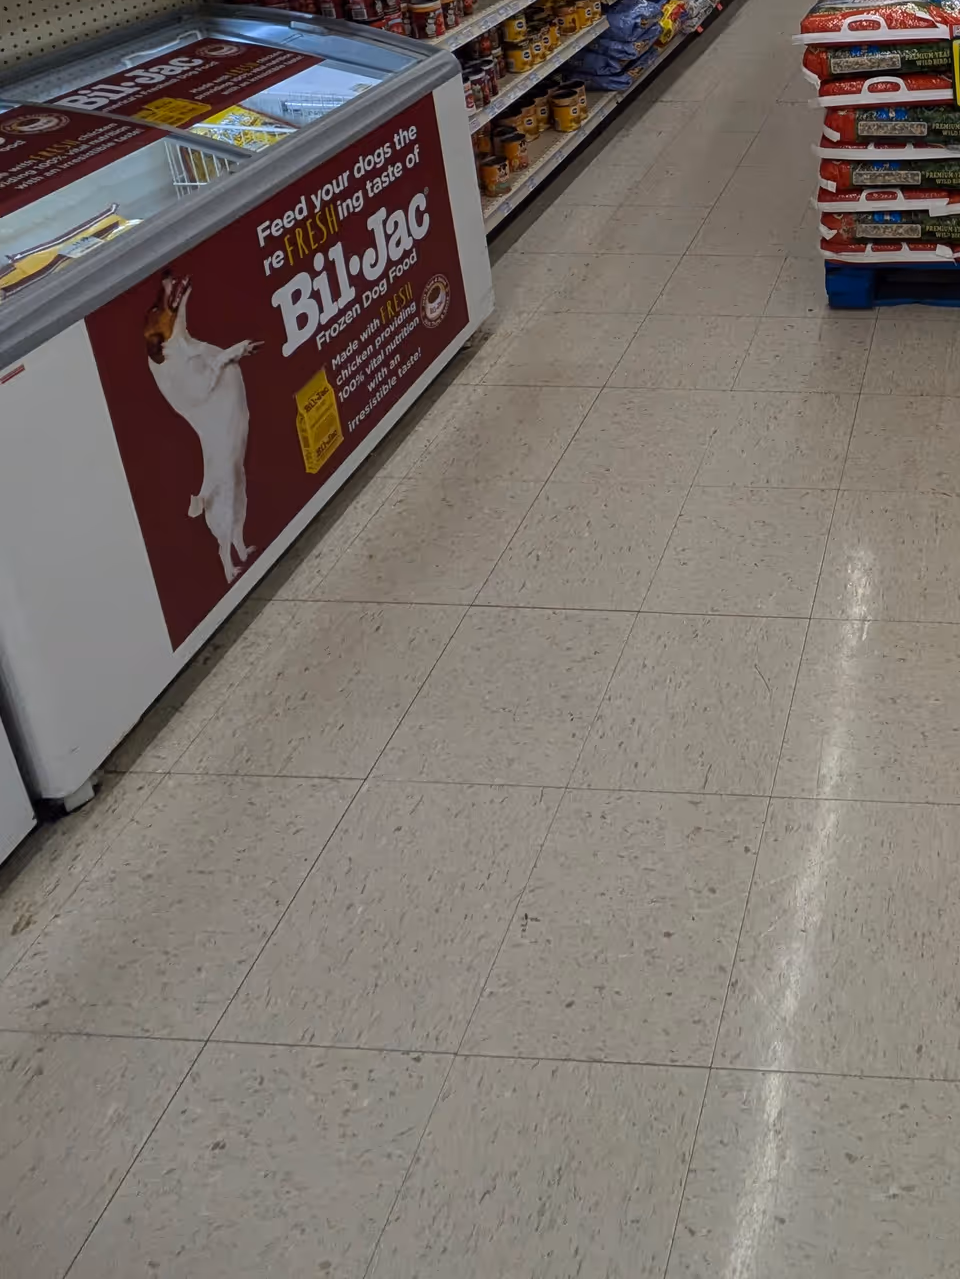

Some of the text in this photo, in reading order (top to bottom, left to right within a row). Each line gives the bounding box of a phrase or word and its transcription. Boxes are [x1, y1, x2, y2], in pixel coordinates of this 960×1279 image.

[916, 59, 931, 67] WILD
[14, 176, 44, 190] with
[43, 168, 61, 177] an
[58, 142, 116, 169] irresistible
[34, 155, 68, 170] 100%
[65, 143, 91, 155] vital
[78, 122, 118, 141] chicken
[256, 125, 418, 247] Feed your dogs the
[365, 163, 403, 199] taste
[405, 144, 420, 169] of
[315, 306, 362, 350] Frozen
[361, 280, 388, 309] Dog
[388, 248, 418, 284] Food
[332, 281, 413, 371] Made with FRESH
[335, 344, 374, 386] chicken
[374, 300, 417, 352] providing
[338, 316, 420, 403] 100% vital nutrition
[367, 352, 401, 393] with an
[347, 346, 422, 432] irresistible taste!
